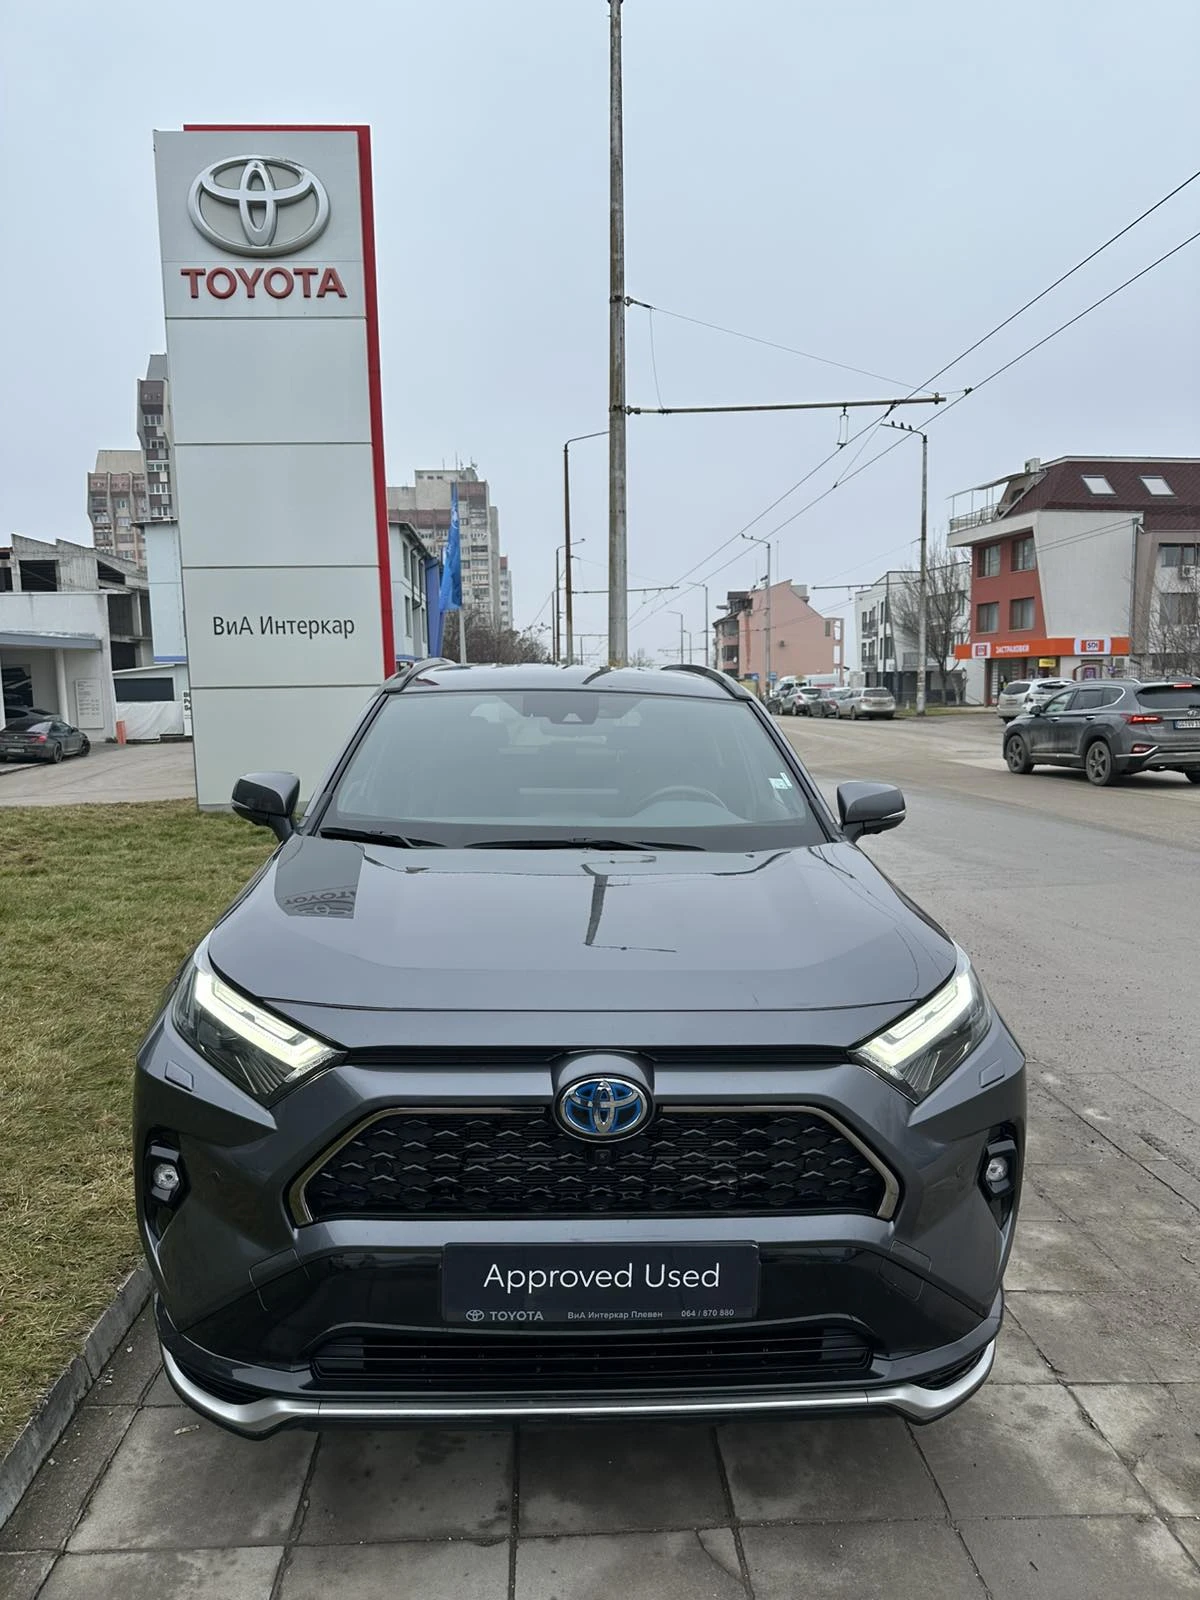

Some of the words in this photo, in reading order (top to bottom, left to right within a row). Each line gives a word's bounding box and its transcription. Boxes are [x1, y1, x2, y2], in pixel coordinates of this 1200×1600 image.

[180, 267, 348, 299] TOYOTA
[213, 616, 254, 635] ВиА
[260, 616, 355, 640] Интеркар
[483, 1262, 633, 1294] Approved
[645, 1262, 720, 1288] Used
[489, 1311, 544, 1321] TOYOTA
[567, 1311, 586, 1320] ВиА
[588, 1310, 629, 1322] Интеркар
[631, 1310, 663, 1319] Плевен
[681, 1309, 697, 1317] 064
[702, 1309, 718, 1317] 870
[719, 1308, 735, 1317] 880
